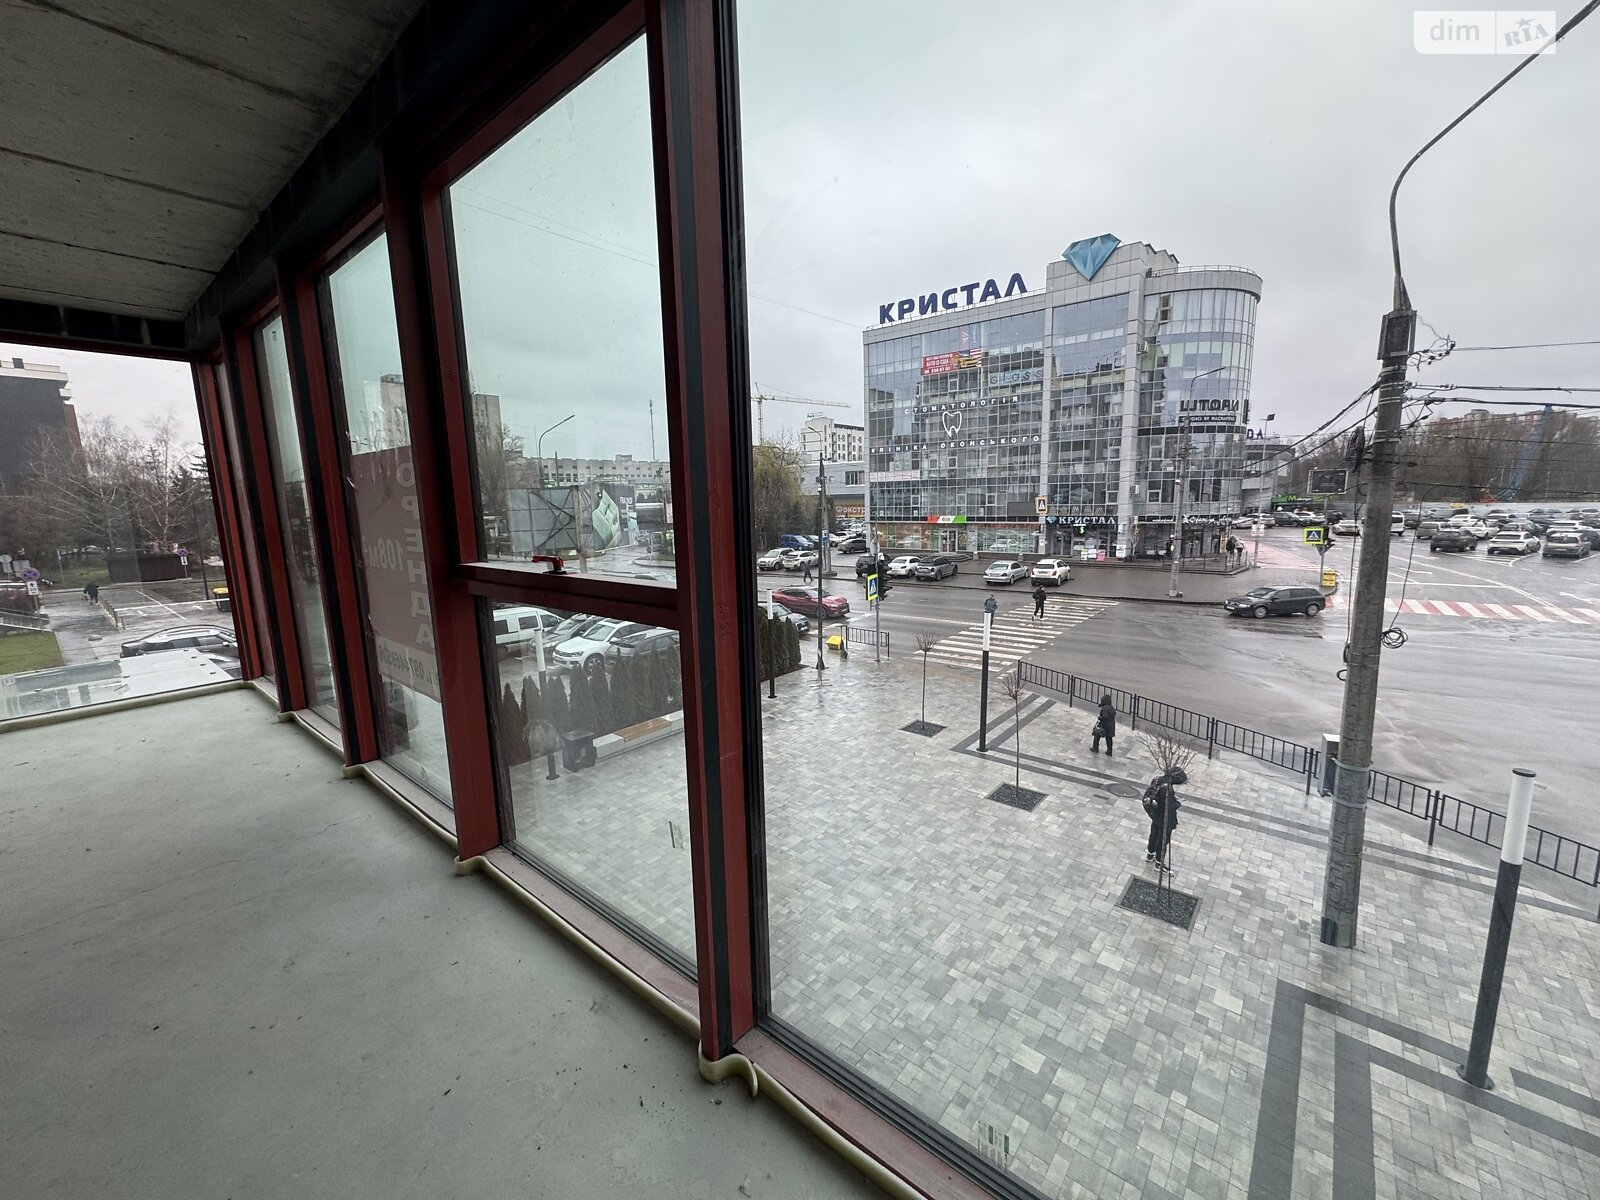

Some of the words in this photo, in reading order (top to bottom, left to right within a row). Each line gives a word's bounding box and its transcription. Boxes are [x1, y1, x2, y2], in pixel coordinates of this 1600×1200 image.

[879, 272, 1028, 324] КРИСТАЛ
[904, 396, 1018, 414] СТОМАТОЛОГІЯ
[1180, 399, 1239, 412] ШТОРИ
[871, 443, 928, 453] КЛІНІКА
[940, 435, 1040, 449] ОКОНСЬКОГО
[1059, 516, 1116, 525] КРИСТАЛ
